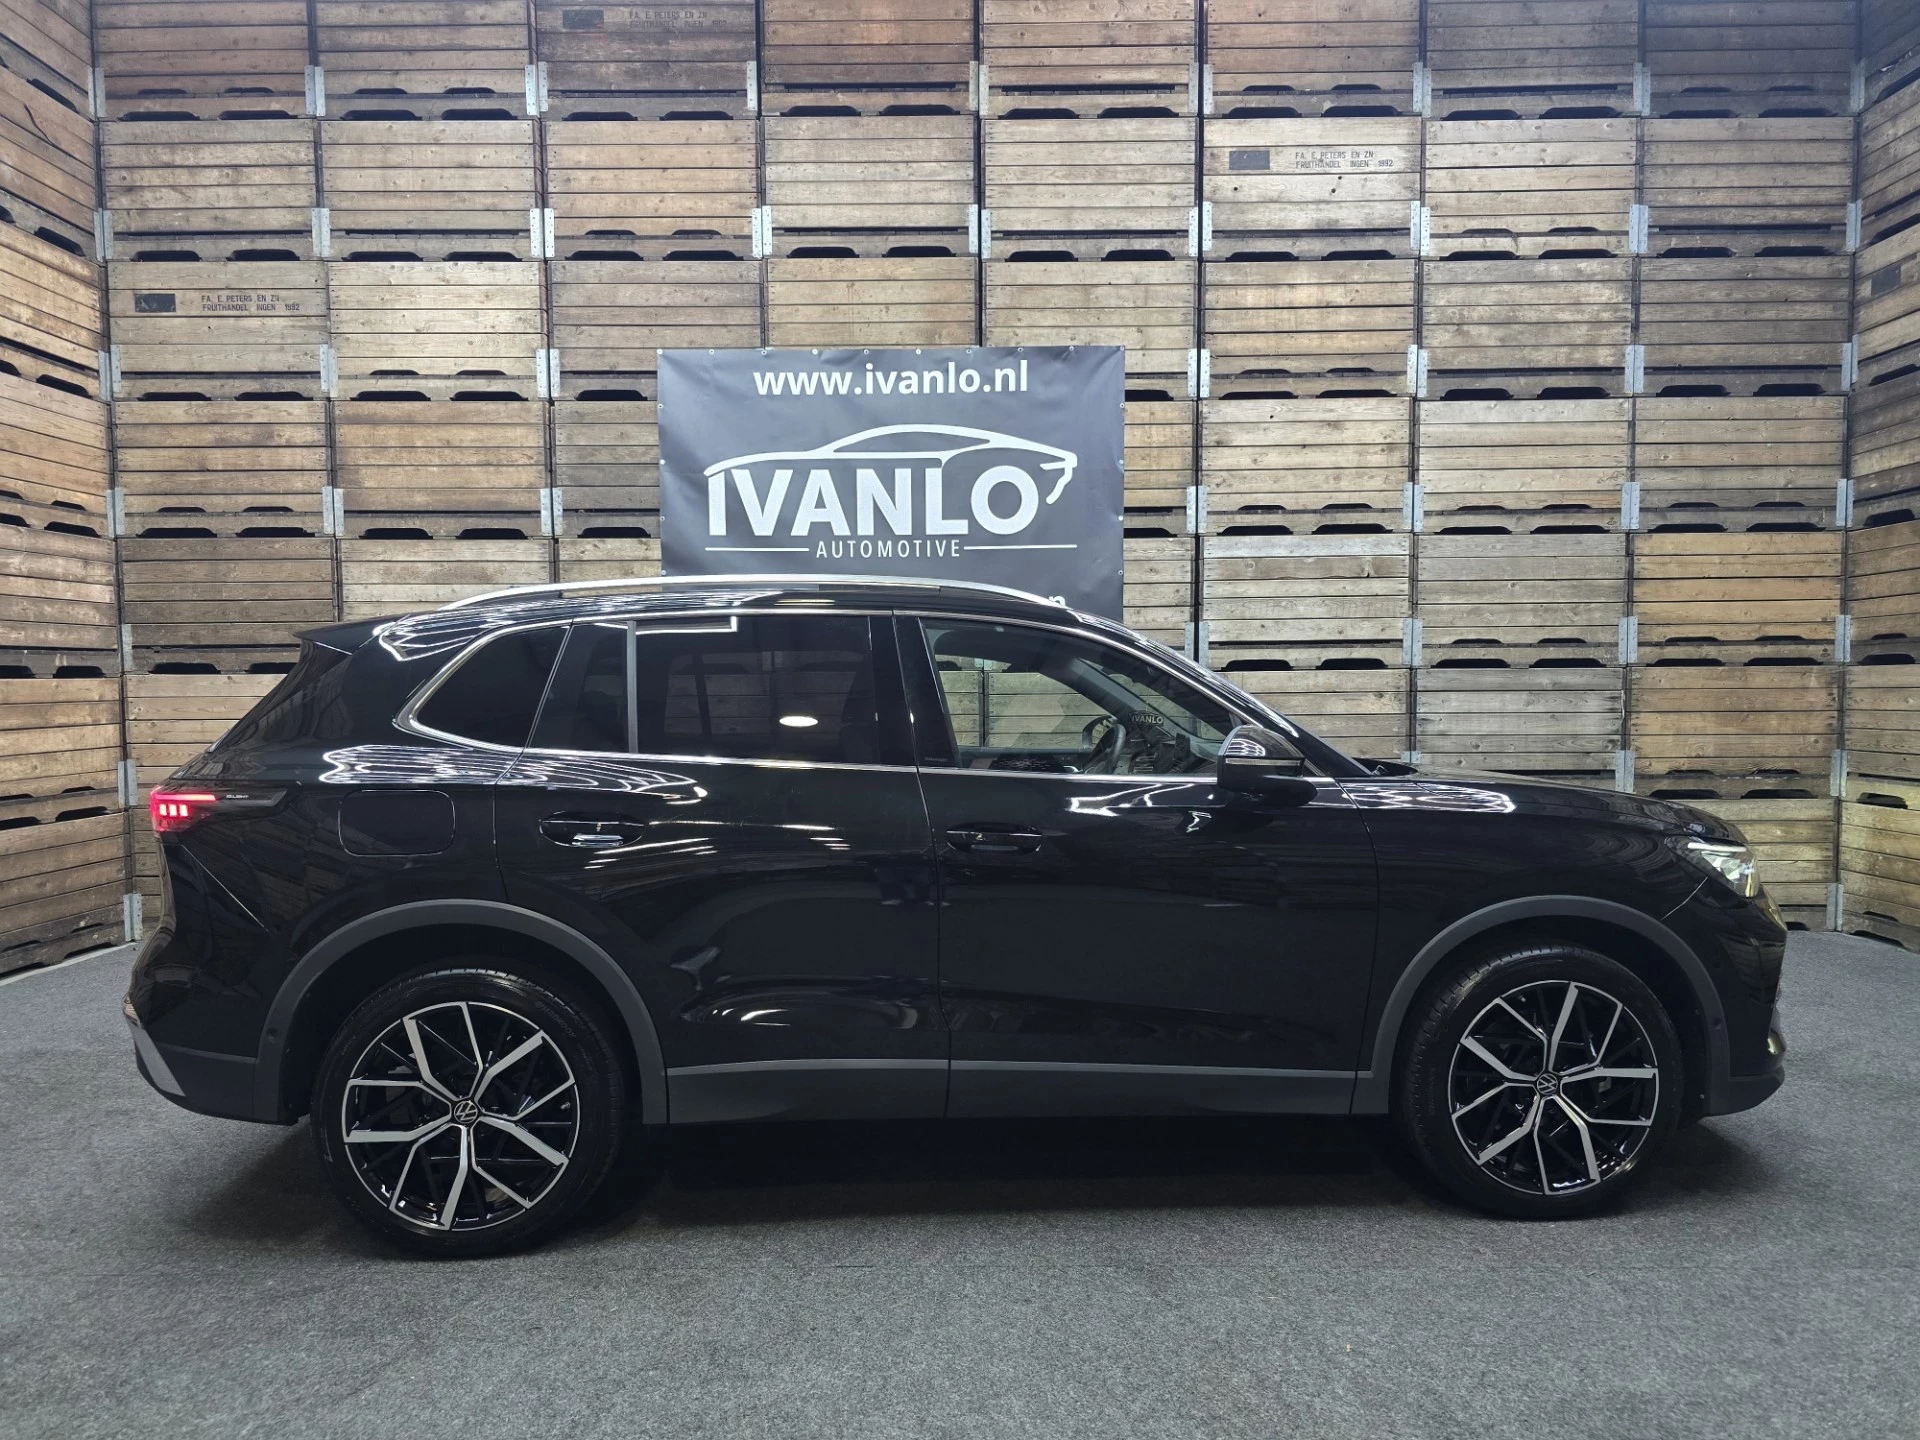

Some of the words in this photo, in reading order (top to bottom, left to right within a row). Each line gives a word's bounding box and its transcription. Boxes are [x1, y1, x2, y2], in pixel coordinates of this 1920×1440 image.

[1320, 151, 1347, 160] PETERS
[1350, 151, 1360, 159] EN
[1364, 150, 1374, 159] ZN
[226, 294, 253, 303] PETERS
[202, 303, 248, 312] FRUITHANDEL
[753, 360, 1028, 396] www.ivanlo.nl
[708, 464, 1039, 537] IVANLO
[816, 539, 961, 558] AUTOMOTIVE
